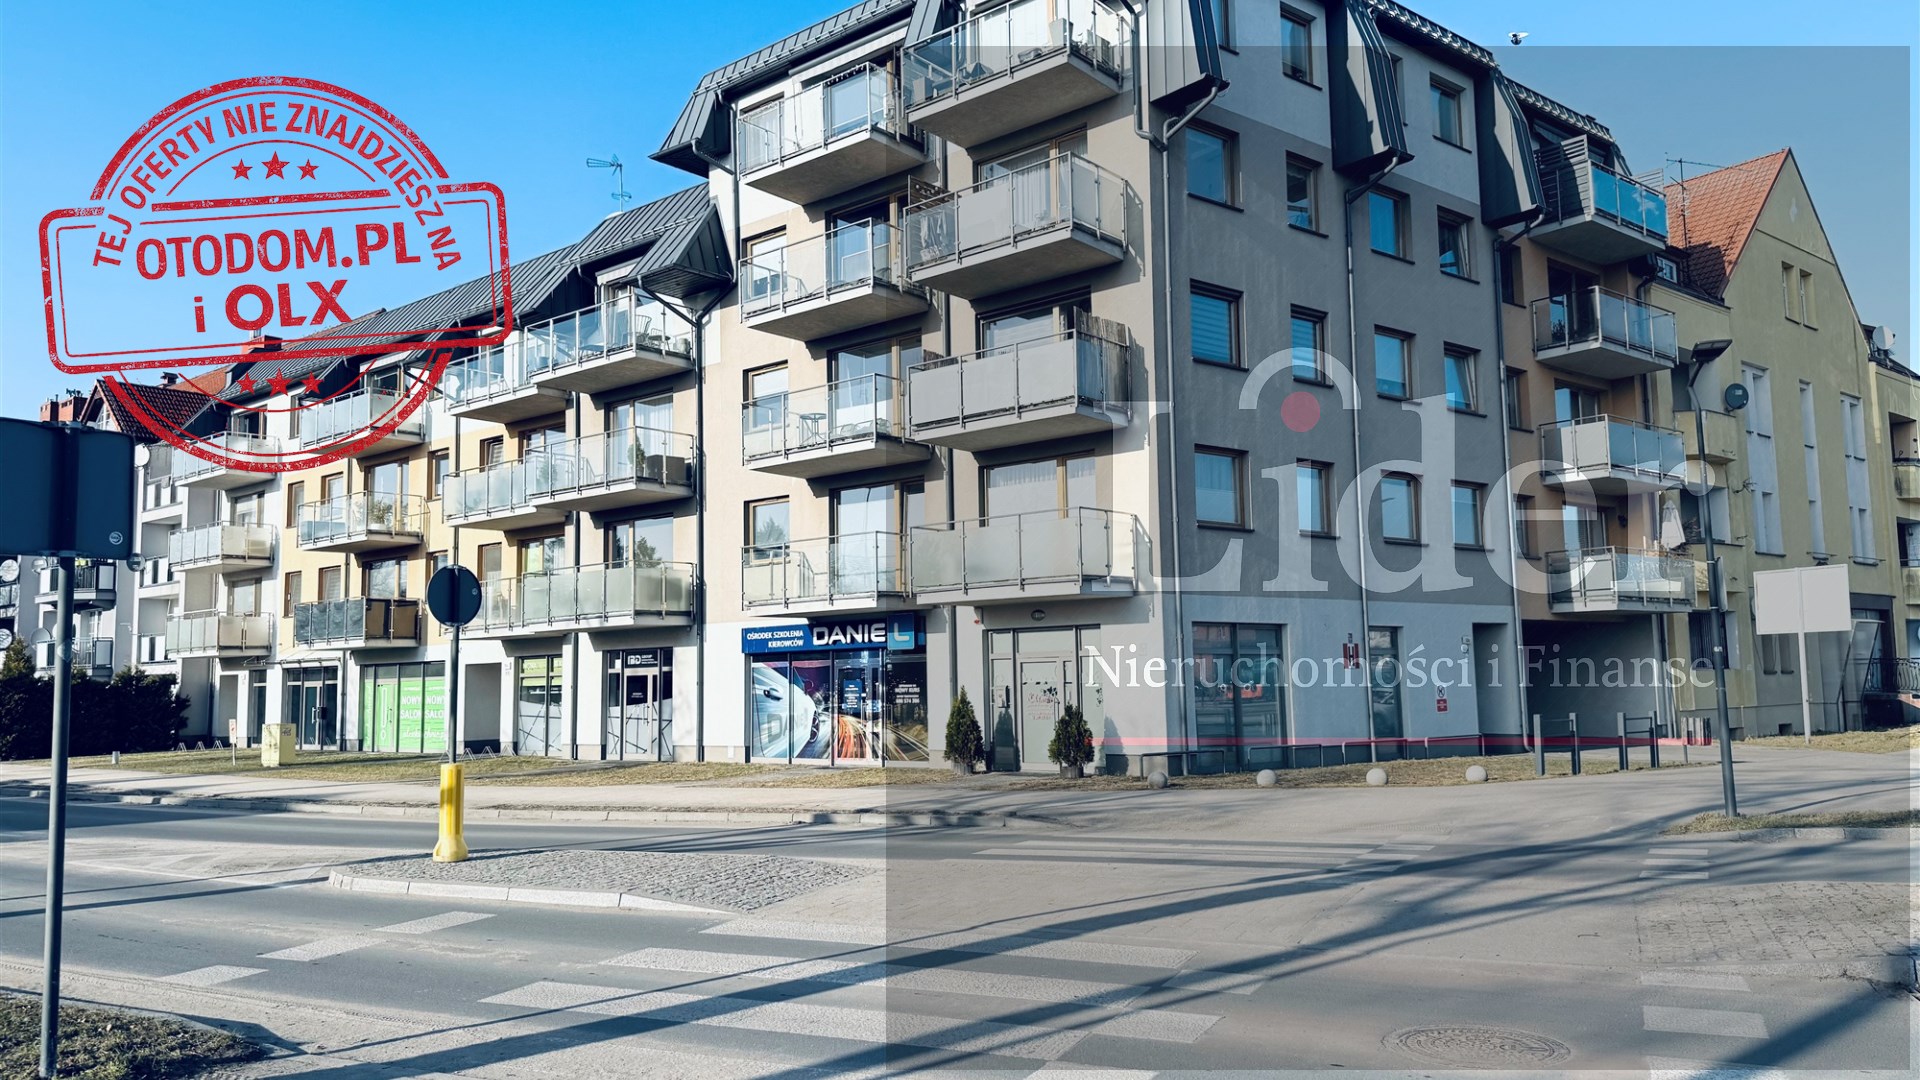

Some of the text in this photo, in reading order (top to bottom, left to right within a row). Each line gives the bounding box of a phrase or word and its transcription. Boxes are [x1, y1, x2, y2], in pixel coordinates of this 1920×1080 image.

[747, 630, 804, 640] OŚRODEK SZKOLENIA
[812, 622, 910, 646] DANIEL
[768, 639, 804, 648] KIEROWCÓW
